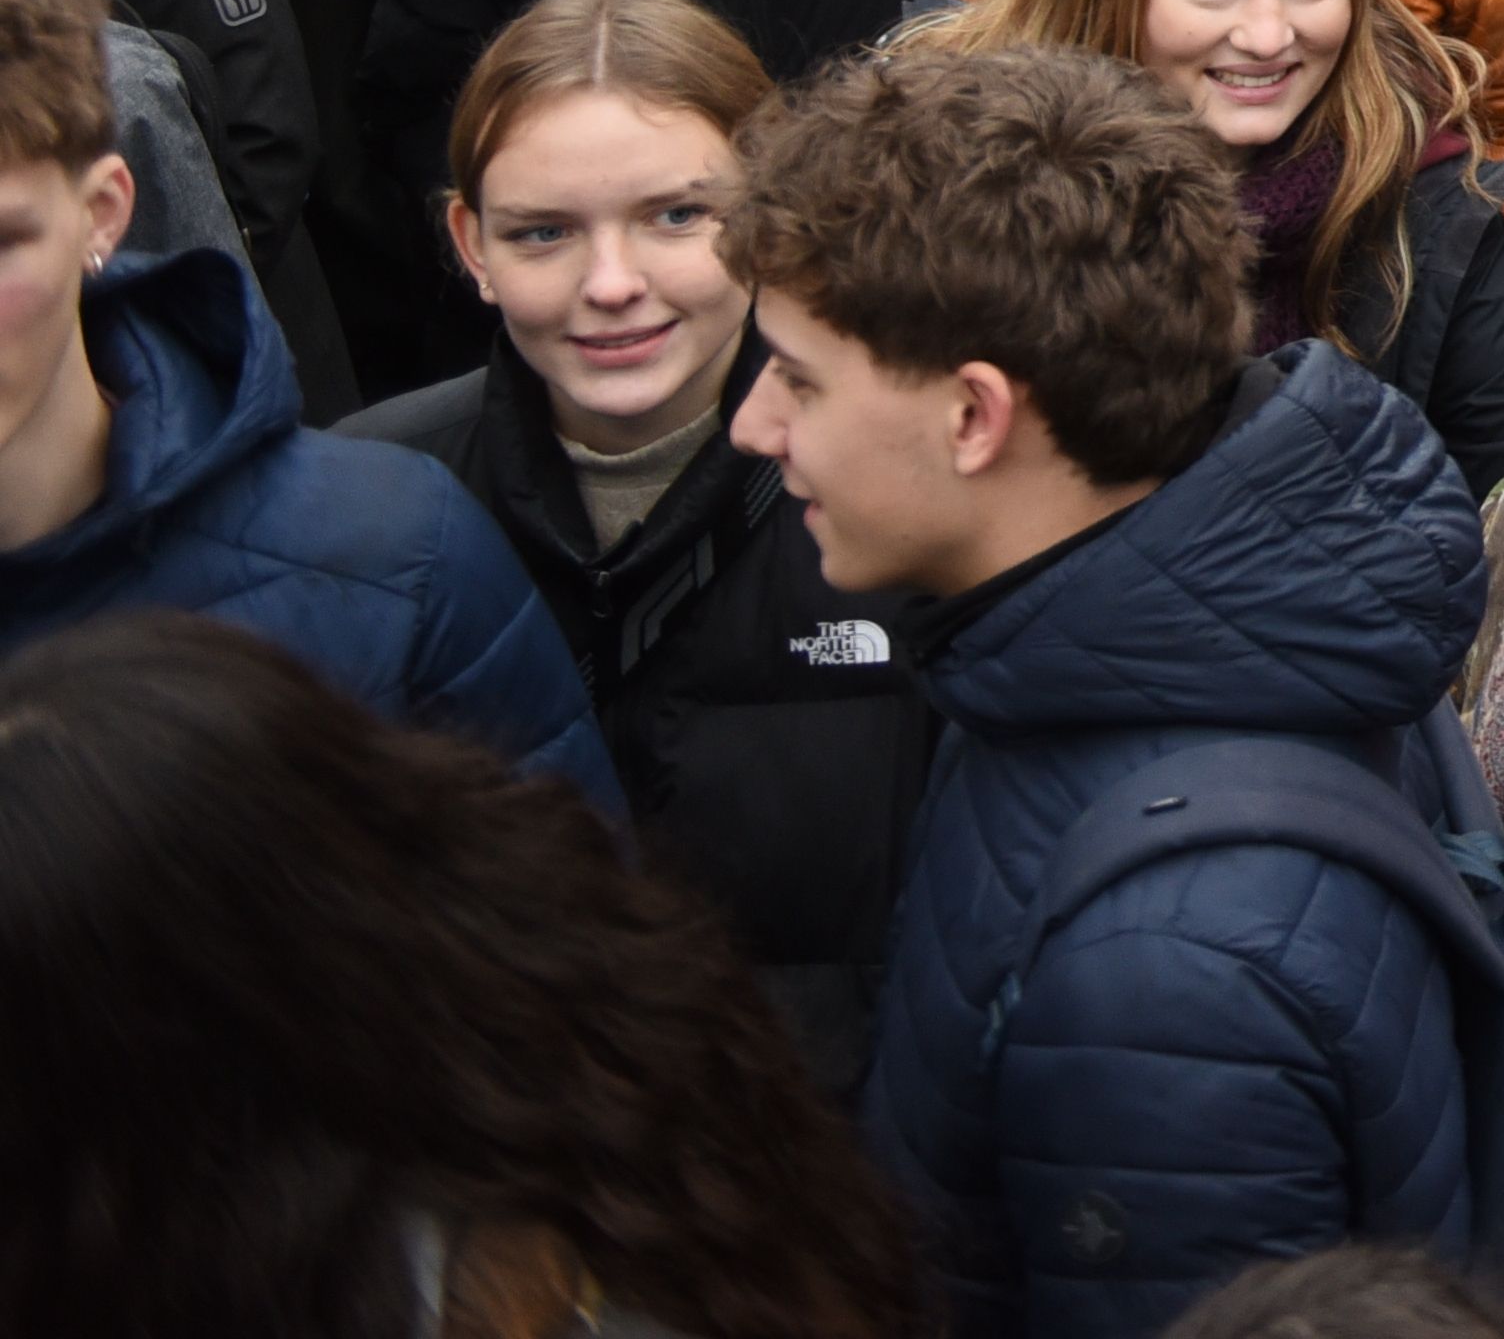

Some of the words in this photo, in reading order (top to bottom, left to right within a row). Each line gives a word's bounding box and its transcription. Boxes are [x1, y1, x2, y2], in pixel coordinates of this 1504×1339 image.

[816, 621, 855, 637] THE
[789, 635, 855, 652] NORTH
[808, 650, 856, 665] FACE
